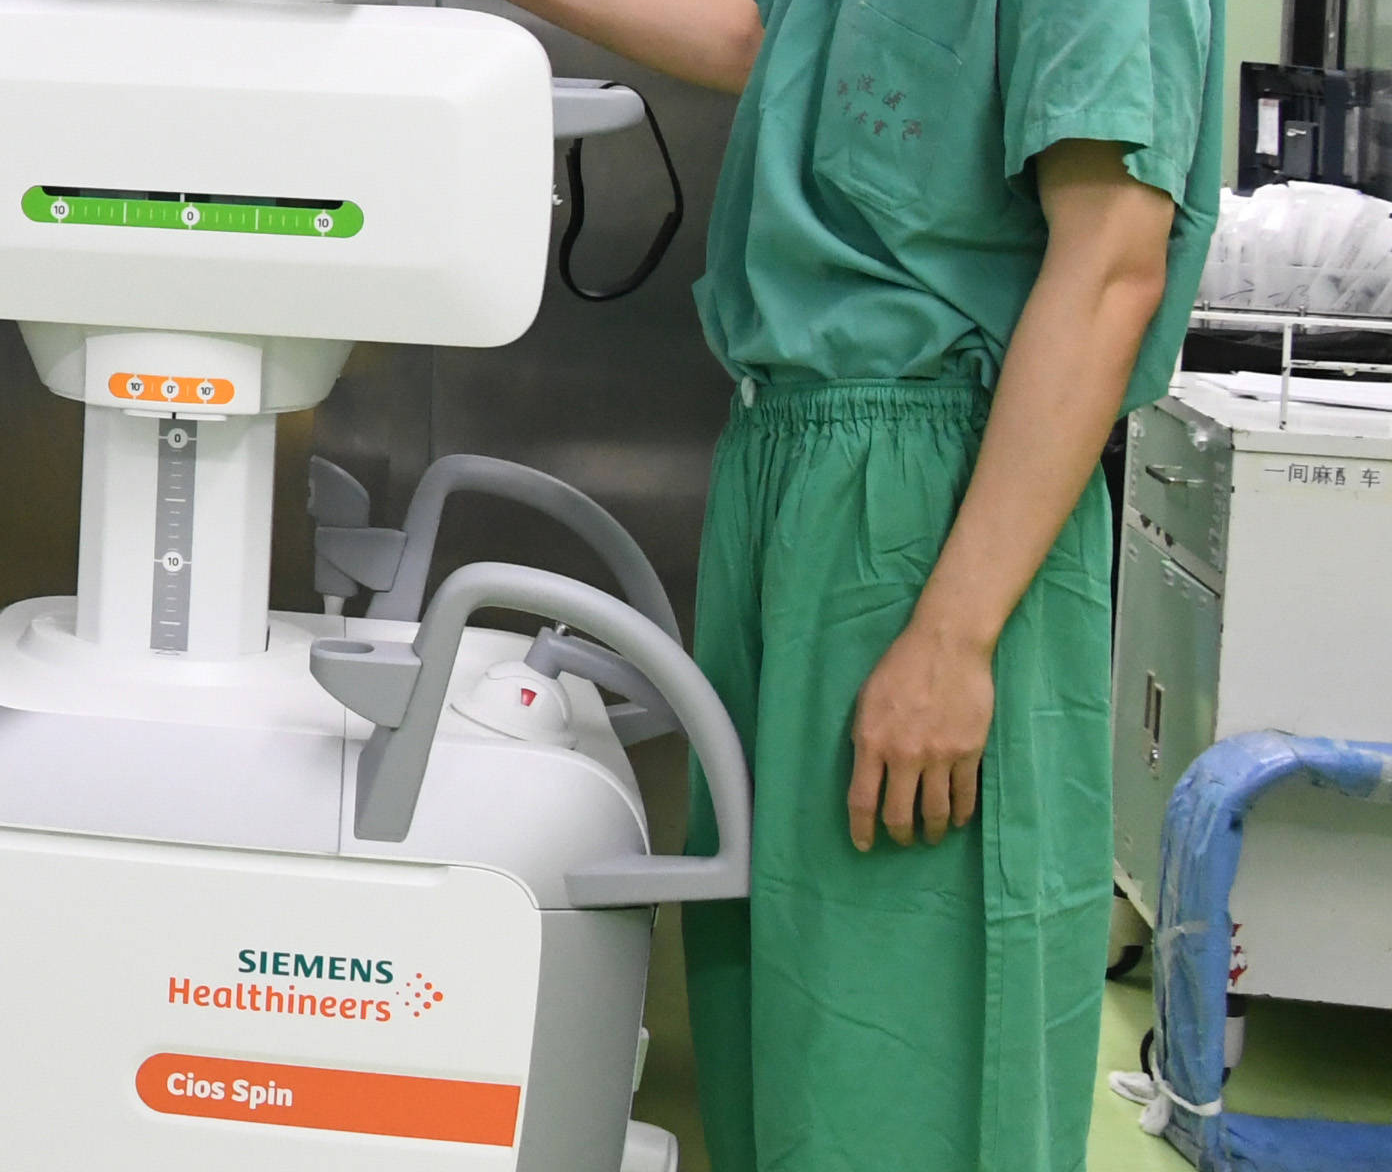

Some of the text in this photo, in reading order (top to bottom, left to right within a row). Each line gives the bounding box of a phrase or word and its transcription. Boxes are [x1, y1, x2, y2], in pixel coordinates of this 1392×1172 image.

[54, 205, 66, 216] 10
[317, 218, 329, 229] 10
[167, 557, 180, 568] 10
[238, 948, 394, 985] SIEMENS
[168, 976, 392, 1023] Healthineers
[166, 1072, 294, 1110] Cios Spin
